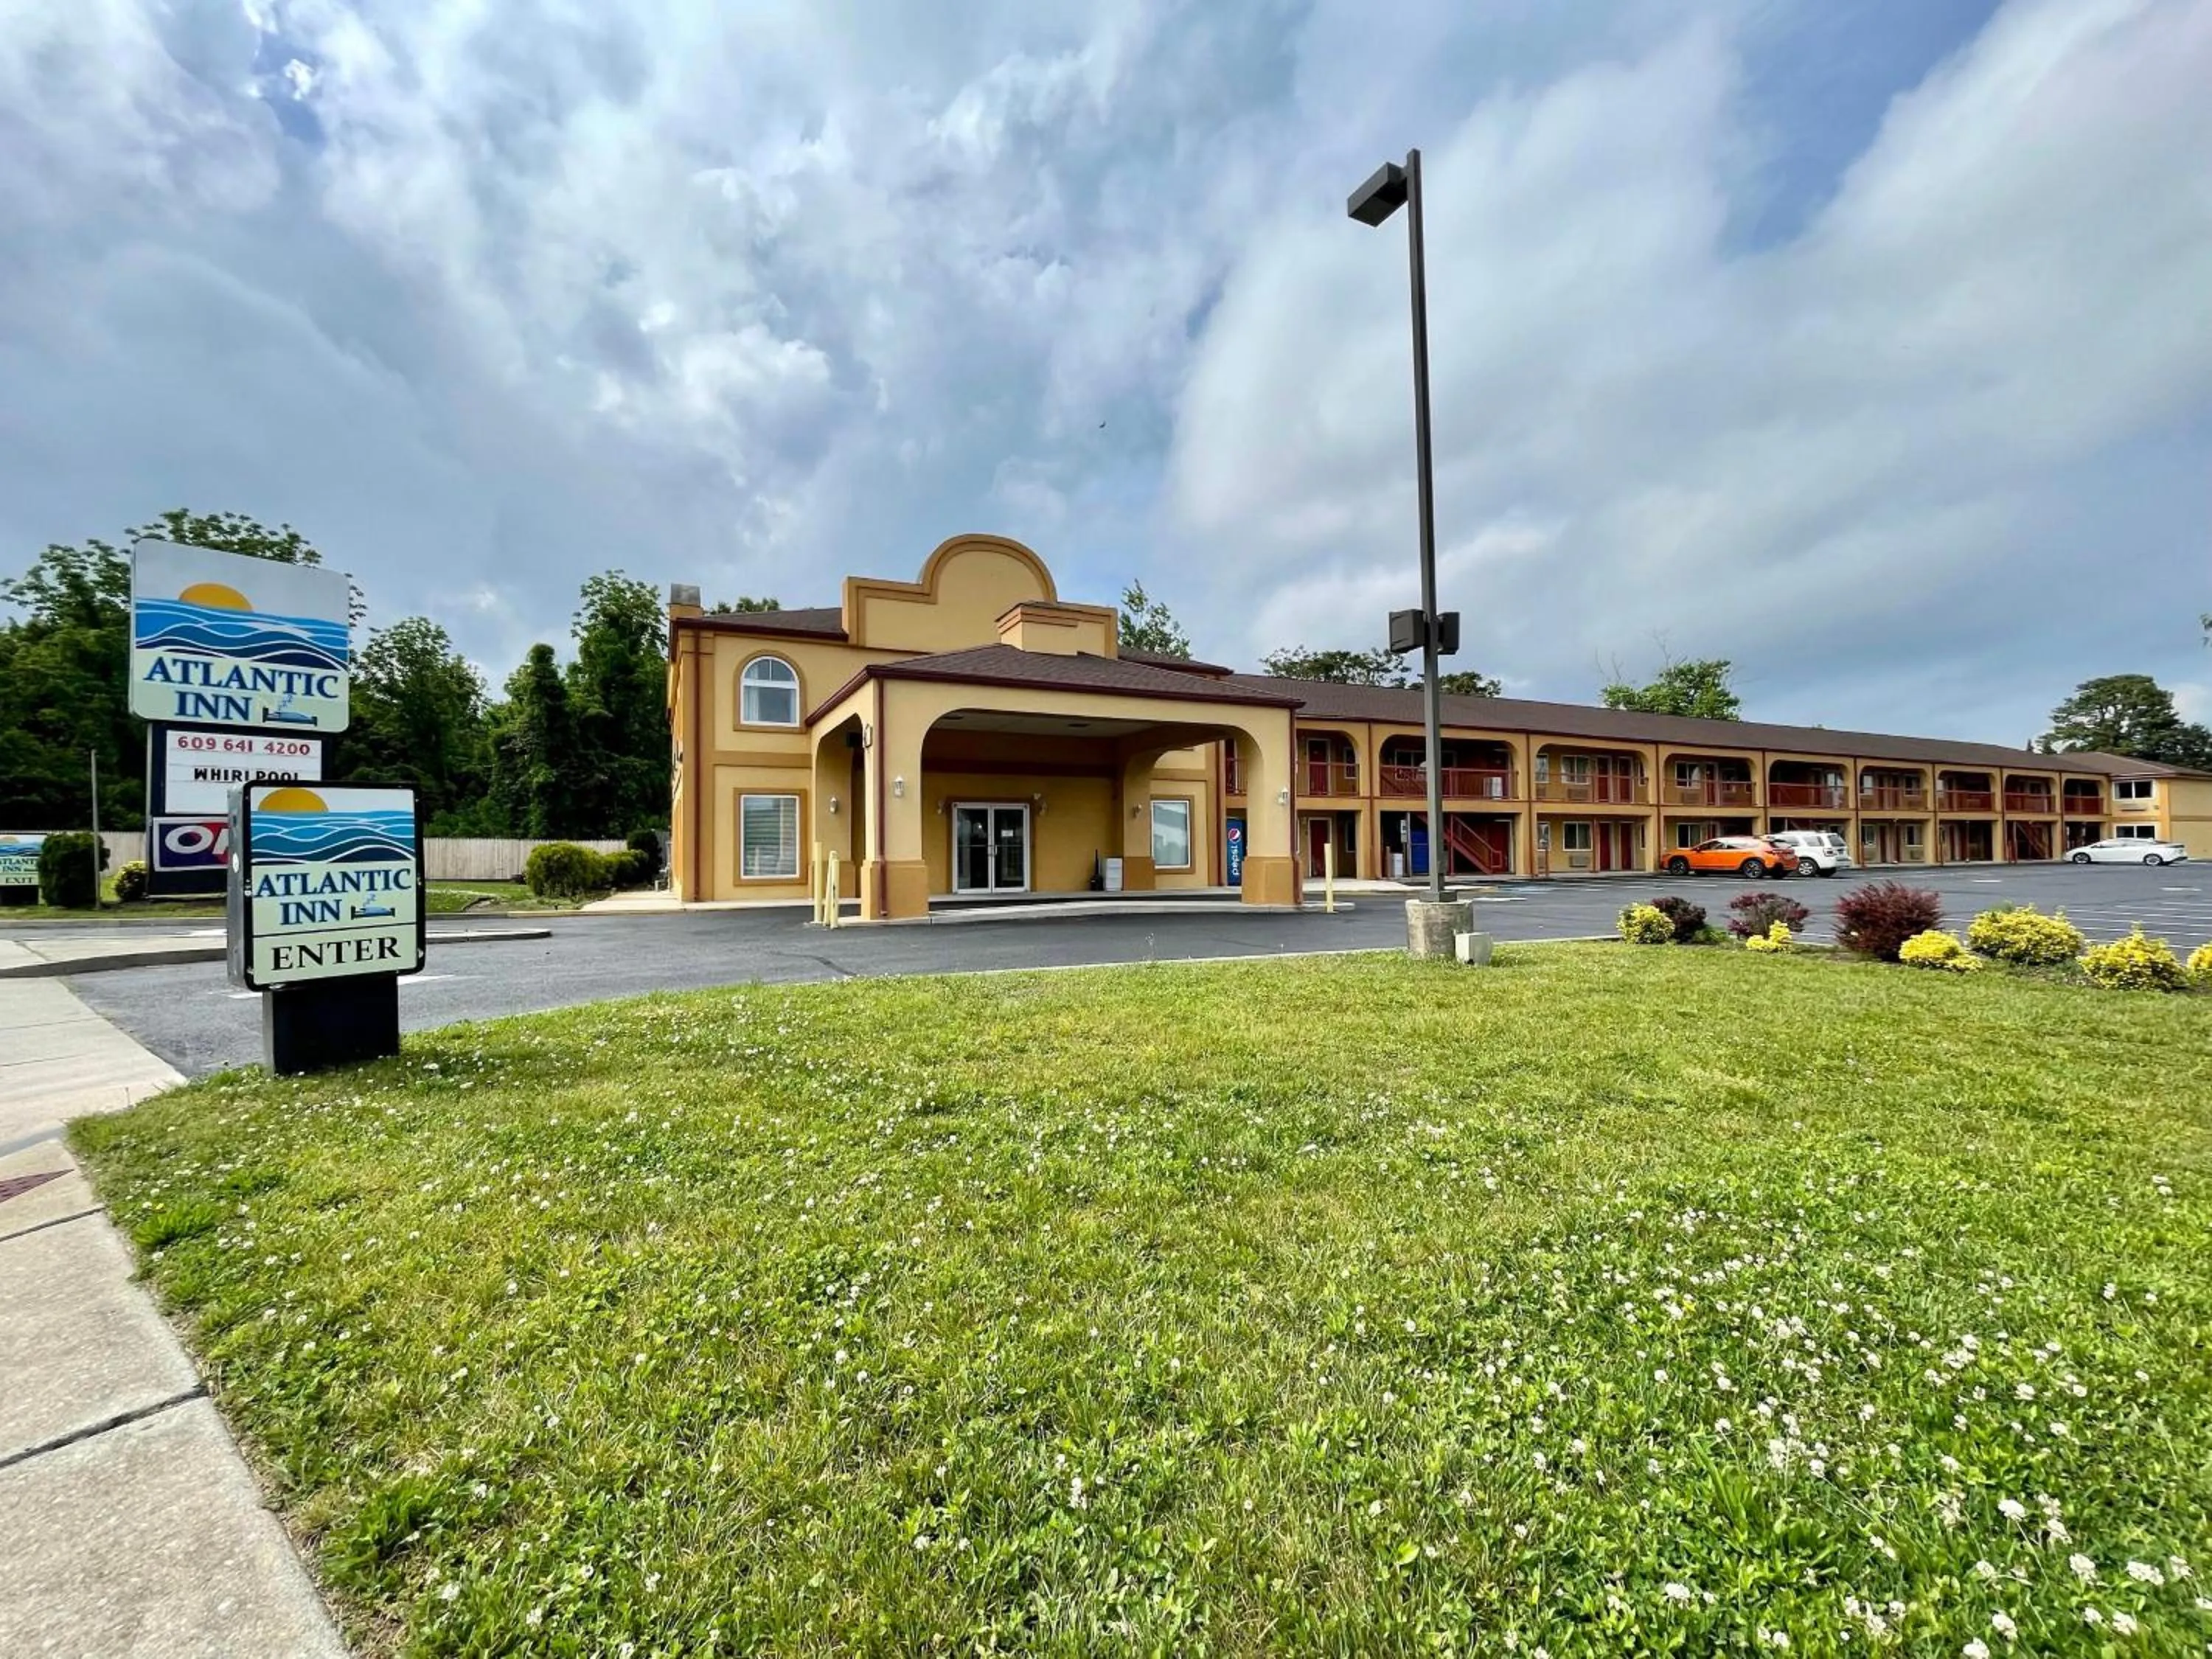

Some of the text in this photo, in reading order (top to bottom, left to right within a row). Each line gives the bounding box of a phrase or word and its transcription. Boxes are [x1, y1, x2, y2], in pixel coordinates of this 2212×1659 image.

[143, 656, 338, 698] ATLANTIC
[174, 690, 252, 720] INN
[178, 736, 310, 755] 609 641 4200
[254, 868, 411, 897] ATLANTIC
[280, 899, 342, 925] INN
[271, 936, 401, 971] ENTER
